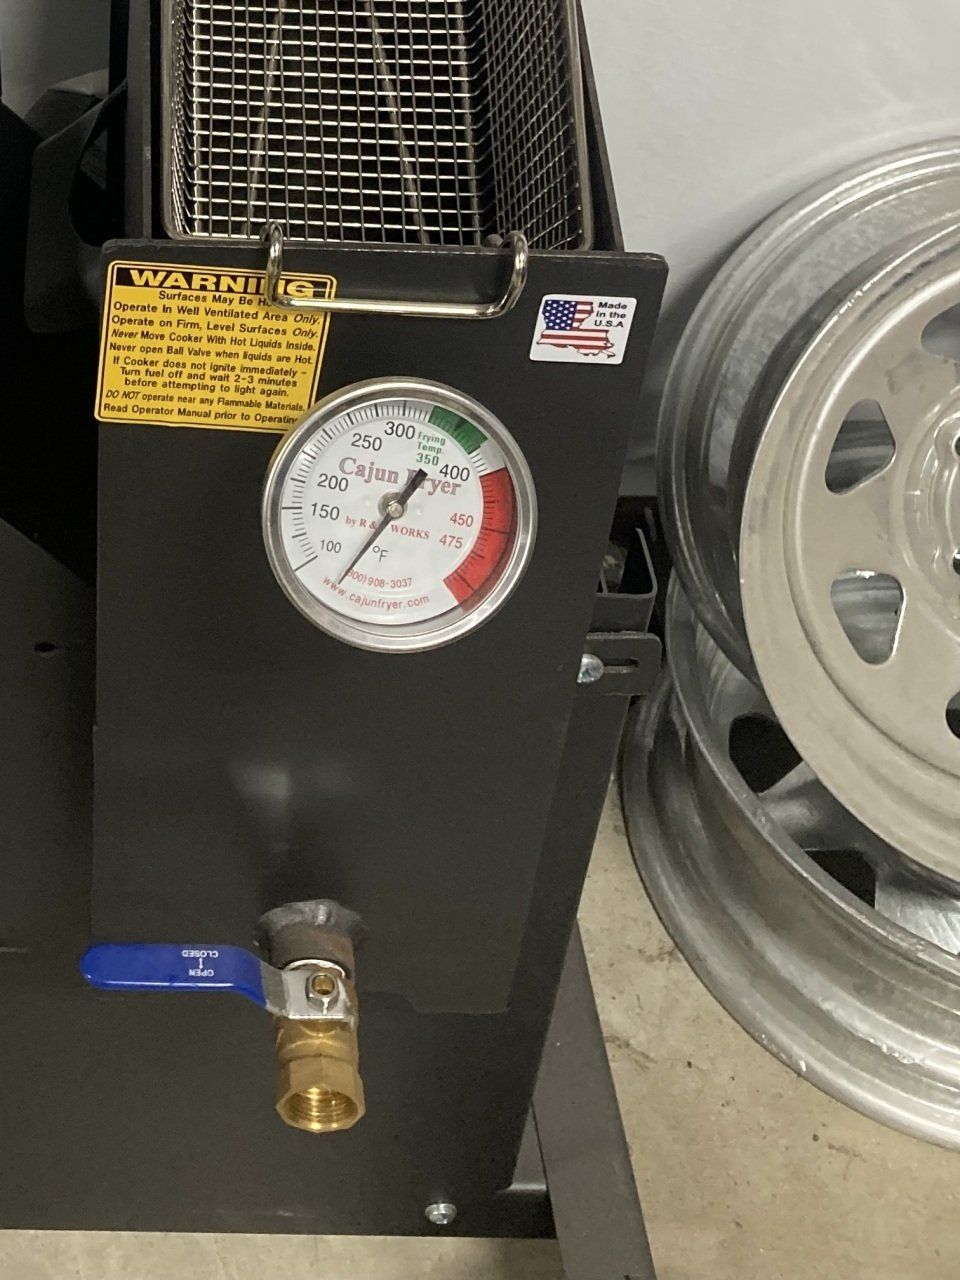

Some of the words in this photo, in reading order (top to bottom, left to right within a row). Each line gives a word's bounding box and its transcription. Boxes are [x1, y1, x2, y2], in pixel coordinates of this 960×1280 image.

[159, 290, 207, 302] Surfaces
[212, 294, 234, 305] May
[239, 295, 253, 306] Be
[598, 301, 627, 310] Made
[113, 301, 157, 312] Operate
[162, 304, 172, 314] In
[177, 305, 199, 316] Well
[204, 307, 258, 320] Ventilated
[263, 312, 288, 322] Area
[294, 313, 320, 325] Only.
[609, 311, 626, 319] the
[111, 315, 154, 326] Operate
[159, 320, 172, 328] on
[177, 319, 202, 331] Firm,
[207, 321, 235, 332] Level
[239, 323, 287, 336] Surfaces
[292, 327, 318, 338] Only.
[594, 320, 624, 328] U.S.A
[111, 328, 138, 339] Never
[141, 330, 165, 341] Move
[169, 332, 203, 343] Cooker
[207, 335, 227, 345] With
[230, 336, 246, 346] Hot
[249, 337, 282, 350] Liquids
[286, 340, 316, 352] Inside.
[109, 342, 136, 352] Never
[139, 346, 163, 355] open
[166, 346, 184, 355] Ball
[188, 347, 211, 357] Valve
[215, 350, 239, 360] when
[242, 351, 272, 362] liquids
[276, 355, 291, 363] are
[113, 355, 120, 365] If
[123, 356, 159, 367] Cooker
[163, 359, 186, 369] does
[190, 361, 206, 370] not
[240, 364, 298, 378] immediately
[120, 366, 141, 376] Turn
[145, 368, 164, 378] fuel
[168, 370, 183, 379] off
[187, 372, 206, 381] and
[209, 373, 230, 382] wait
[234, 374, 254, 384] 2-3
[258, 377, 297, 387] minutes
[124, 377, 158, 388] before
[161, 380, 216, 393] attempting
[220, 384, 230, 392] to
[234, 384, 256, 396] light
[259, 388, 289, 398] again.
[106, 389, 120, 399] DO
[121, 391, 141, 400] NOT
[142, 393, 174, 402] operate
[177, 396, 196, 404] near
[199, 397, 214, 407] any
[217, 397, 262, 409] Flammable
[265, 400, 305, 412] Materials.
[103, 402, 128, 413] Read
[131, 405, 174, 416] Operator
[177, 407, 211, 418] Manual
[214, 410, 237, 421] prior
[241, 412, 250, 420] to
[384, 421, 416, 440] 300
[417, 431, 446, 446] Frying
[350, 432, 383, 452] 250
[416, 452, 440, 467] 350
[338, 456, 399, 484] Cajun
[440, 463, 470, 482] 400
[317, 473, 349, 492] 200
[311, 502, 340, 521] 150
[450, 512, 474, 528] 450
[345, 515, 356, 527] by
[359, 518, 367, 527] R
[390, 524, 431, 539] WORKS
[320, 539, 342, 554] 100
[439, 534, 464, 549] 475
[181, 949, 219, 958] CLOSED
[188, 969, 215, 977] OPEN
